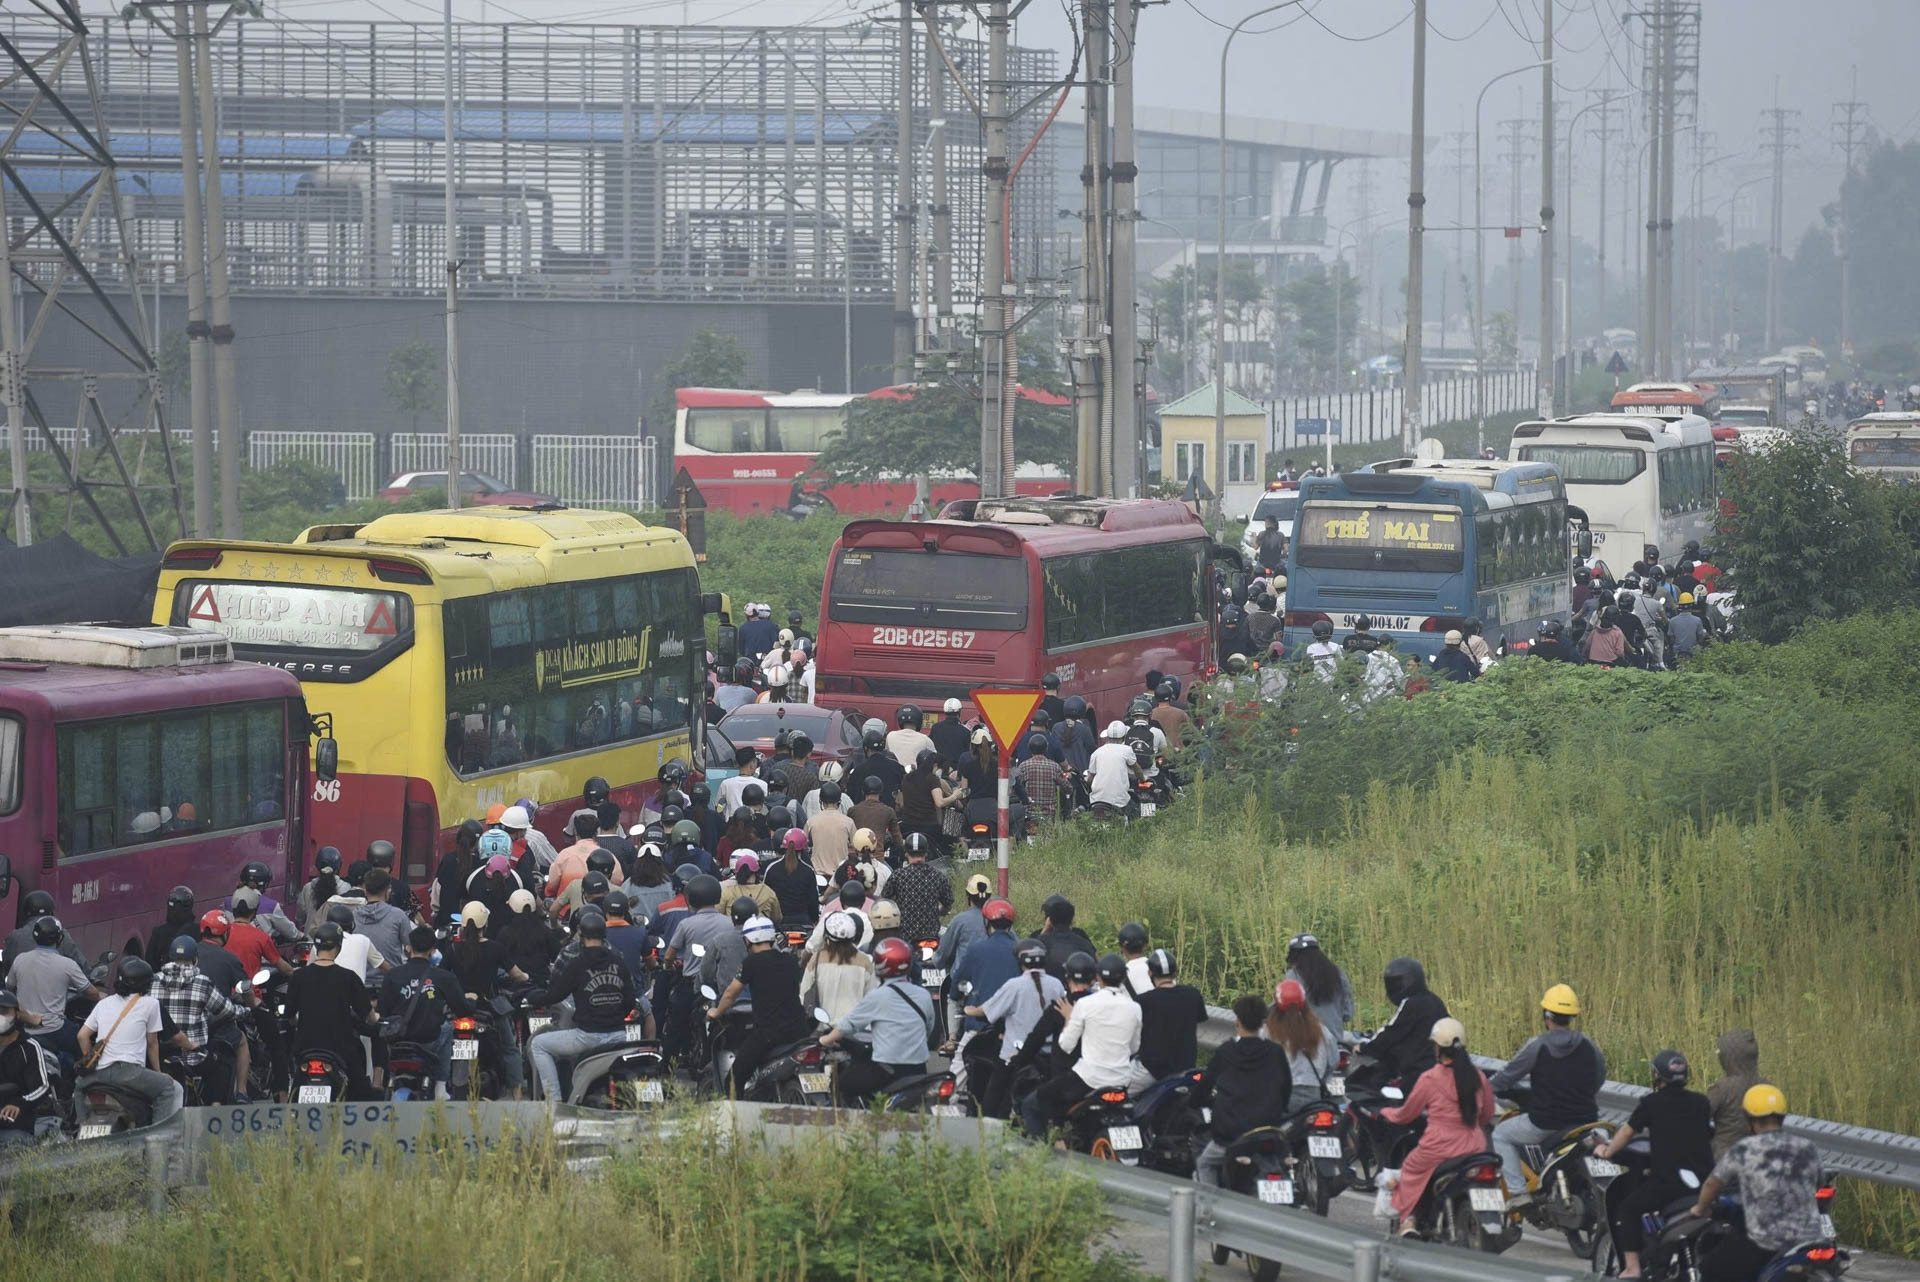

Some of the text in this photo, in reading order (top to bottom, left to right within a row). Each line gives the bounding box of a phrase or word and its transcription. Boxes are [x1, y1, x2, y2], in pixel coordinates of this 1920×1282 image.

[1384, 521, 1430, 541] MAI
[221, 589, 368, 627] HIỆP ANH
